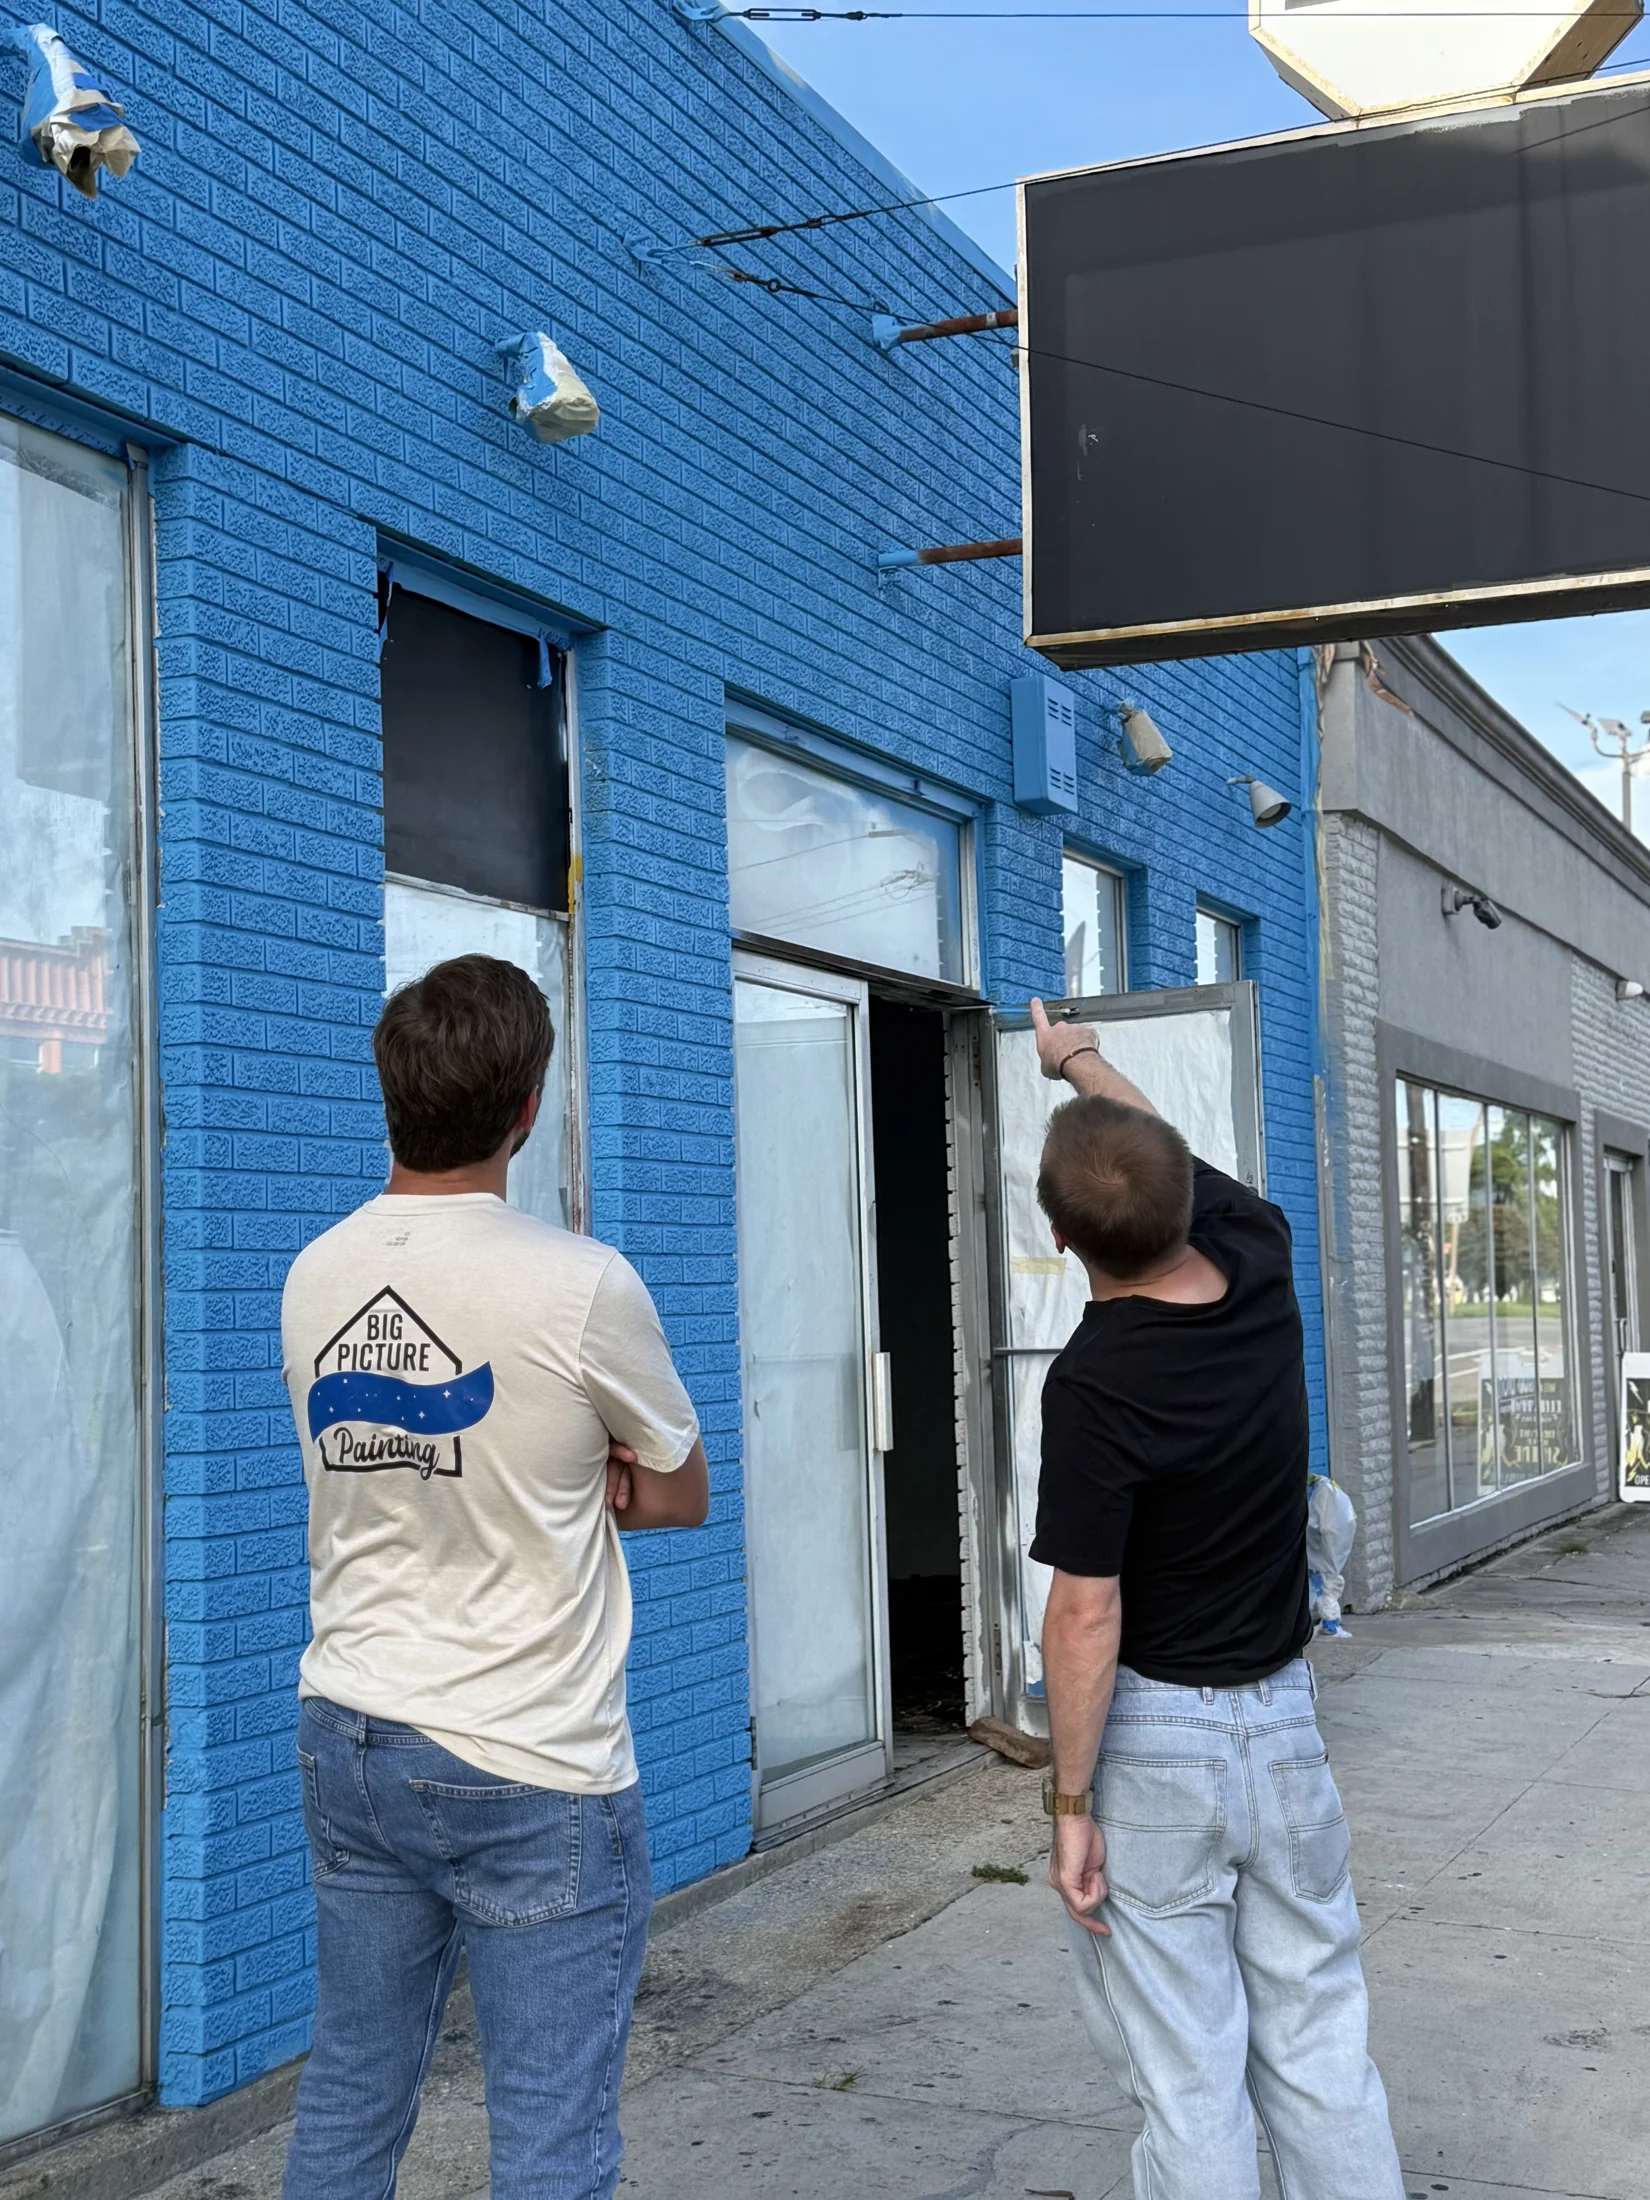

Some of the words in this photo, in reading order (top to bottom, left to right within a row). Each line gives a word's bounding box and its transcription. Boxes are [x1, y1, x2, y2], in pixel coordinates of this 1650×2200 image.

[367, 1313, 403, 1341] BIG
[337, 1342, 431, 1372] PICTURE
[333, 1427, 440, 1480] Painting
